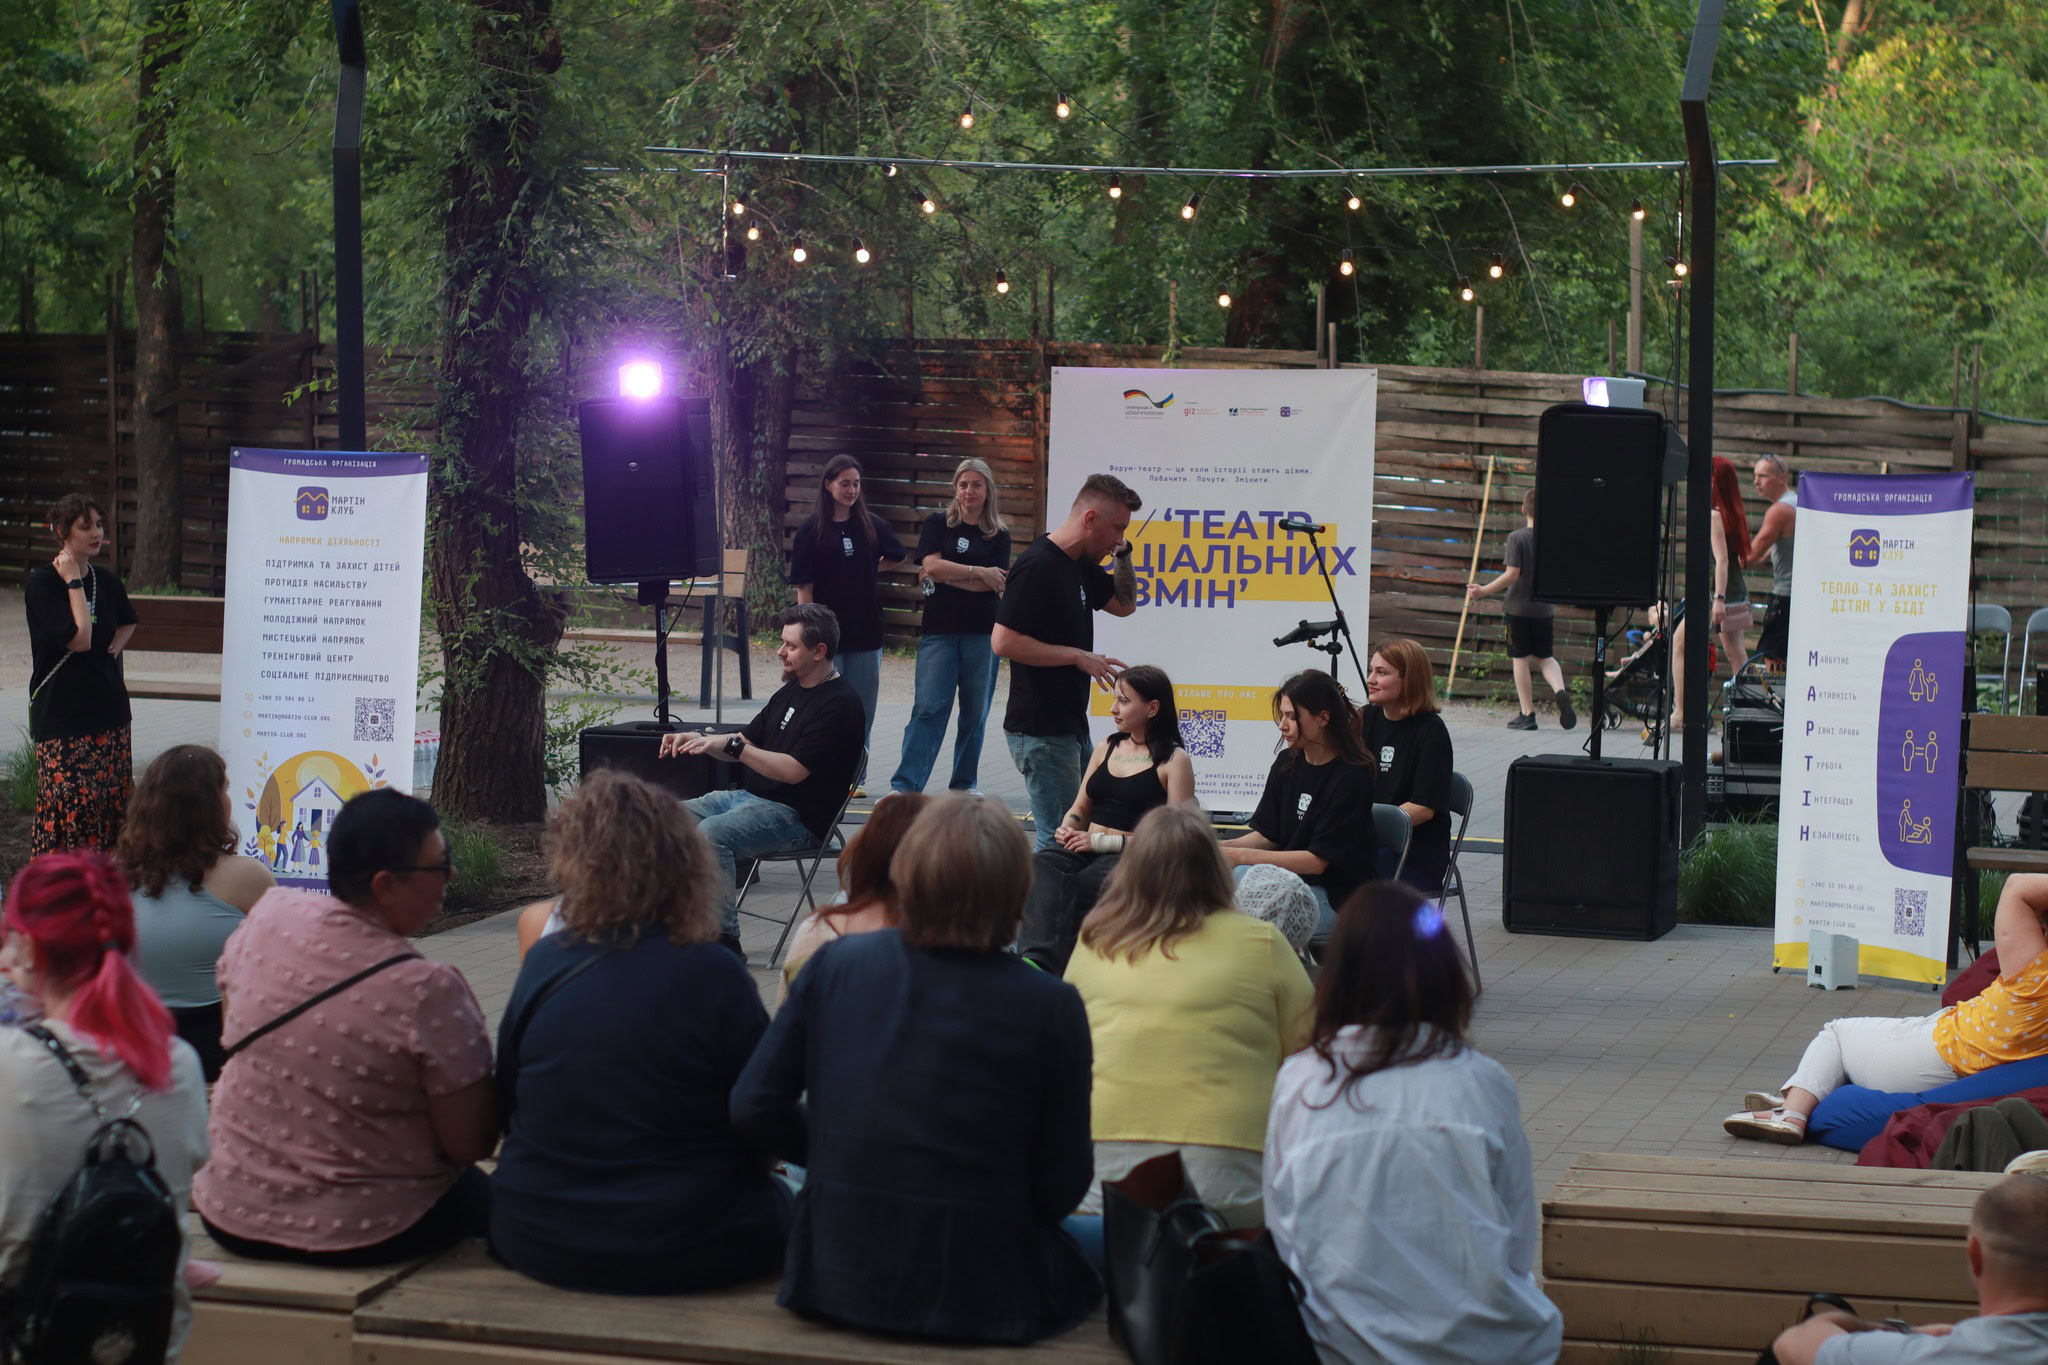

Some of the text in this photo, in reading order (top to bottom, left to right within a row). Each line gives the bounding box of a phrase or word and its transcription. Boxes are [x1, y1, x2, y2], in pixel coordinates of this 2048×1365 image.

[1184, 407, 1196, 416] giz
[283, 458, 377, 469] ГРОМАДСЬКА ОРГАНІЗАЦІЯ
[1109, 465, 1161, 473] Форум-театр
[1214, 466, 1246, 474] історії
[1197, 475, 1229, 484] Почути.
[331, 496, 365, 505] МАРТІН
[1833, 493, 1933, 504] ГРОМАДСЬКА ОРГАНІЗАЦІЯ
[331, 506, 354, 515] КЛУБ
[279, 536, 380, 547] НАПРЯМКИ ДІЯЛЬНОСТІ
[1882, 539, 1915, 550] МАРТІН
[1882, 551, 1904, 561] КЛУБ
[265, 560, 400, 572] ПІДТРИМКА ТА ЗАХИСТ ДІТЕЙ
[264, 578, 368, 589] ПРОТИДІЯ НАСИЛЬСТВУ
[1821, 581, 1937, 598] ТЕПЛО ТА ЗАХИСТ
[264, 596, 382, 608] ГУМАНІТАРНЕ РЕАГУВАННЯ
[1831, 598, 1925, 616] ДІТЯМ У БІДІ
[263, 614, 366, 626] МОЛОДІЖНИЙ НАПРЯМОК
[262, 632, 365, 645] МИСТЕЦЬКИЙ НАПРЯМОК
[262, 651, 354, 664] ТРЕНІНГОВИЙ ЦЕНТР
[260, 670, 390, 684] СОЦІАЛЬНЕ ПІДПРИЄМНИЦТВО
[1178, 688, 1211, 698] БІЛЬШЕ
[1218, 690, 1234, 699] ПРО
[1240, 690, 1256, 699] НАС
[1838, 727, 1860, 736] ПРАВА
